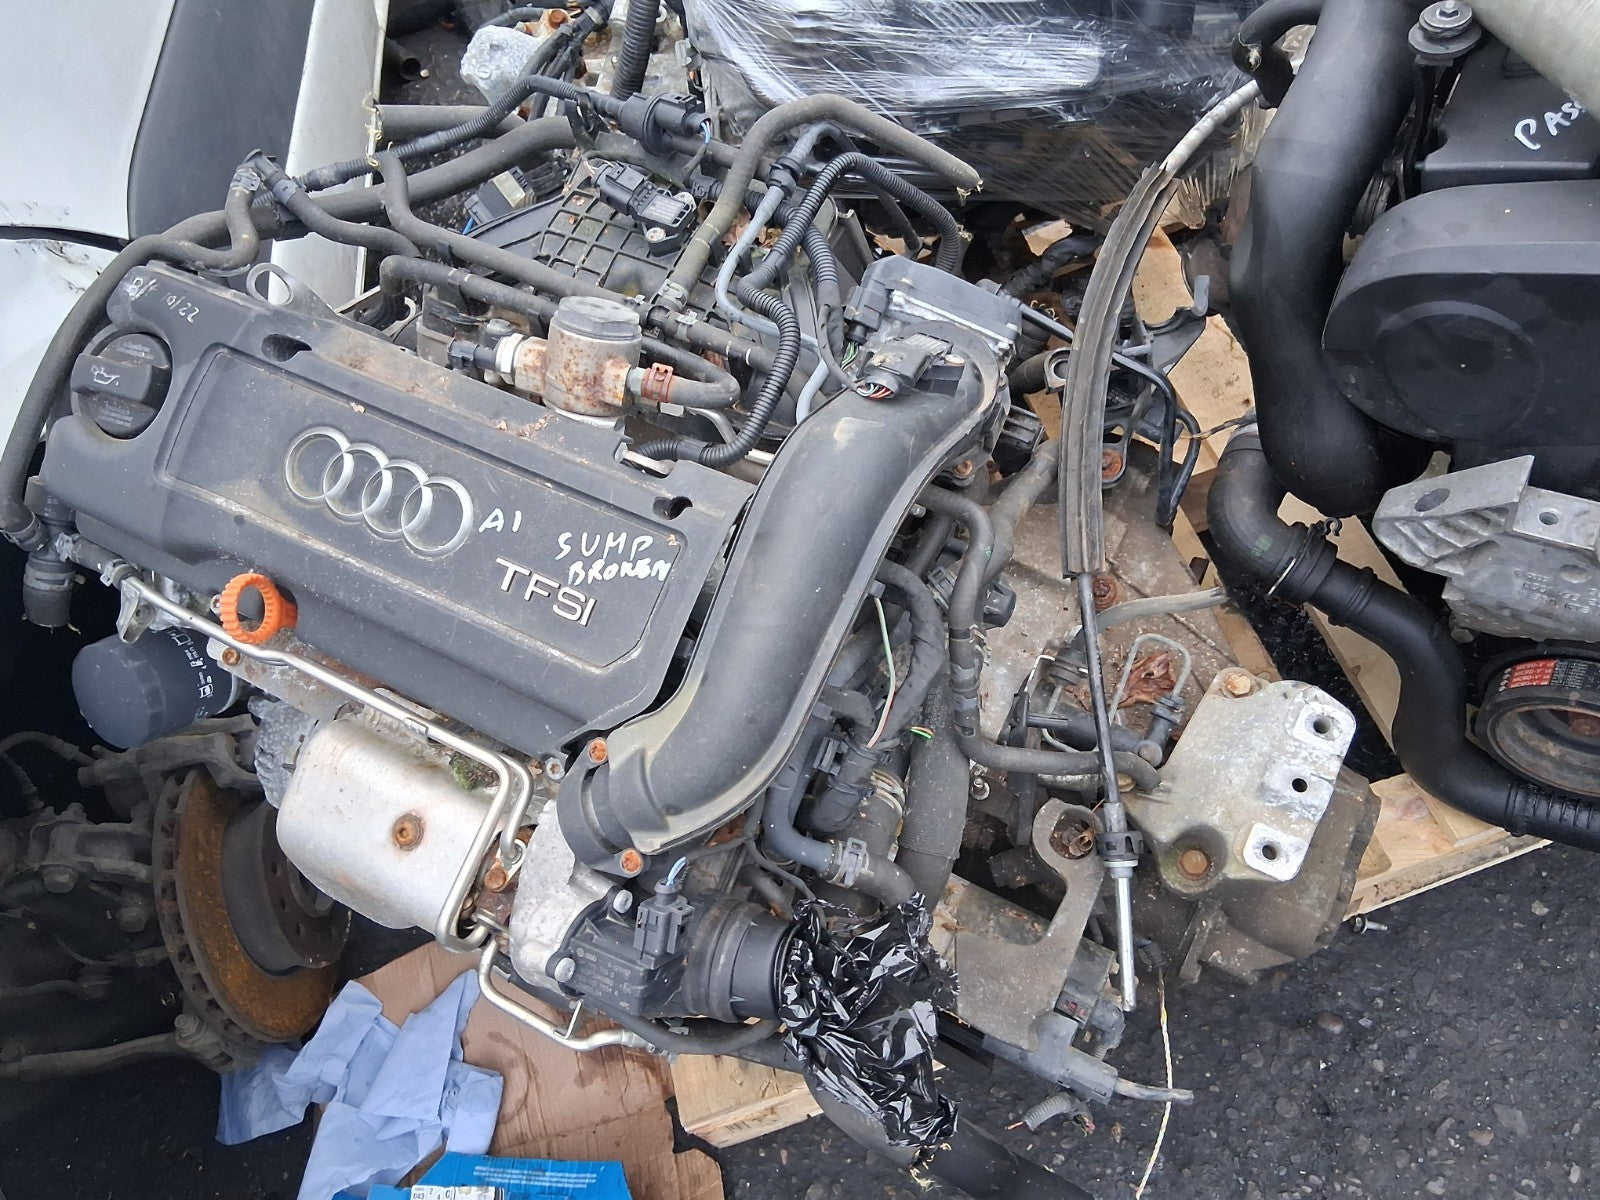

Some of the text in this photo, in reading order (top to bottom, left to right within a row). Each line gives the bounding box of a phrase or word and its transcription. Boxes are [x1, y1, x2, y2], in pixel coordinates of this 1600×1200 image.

[554, 531, 654, 561] SUMP
[567, 558, 672, 586] BROKEN
[496, 557, 597, 626] TFSI
